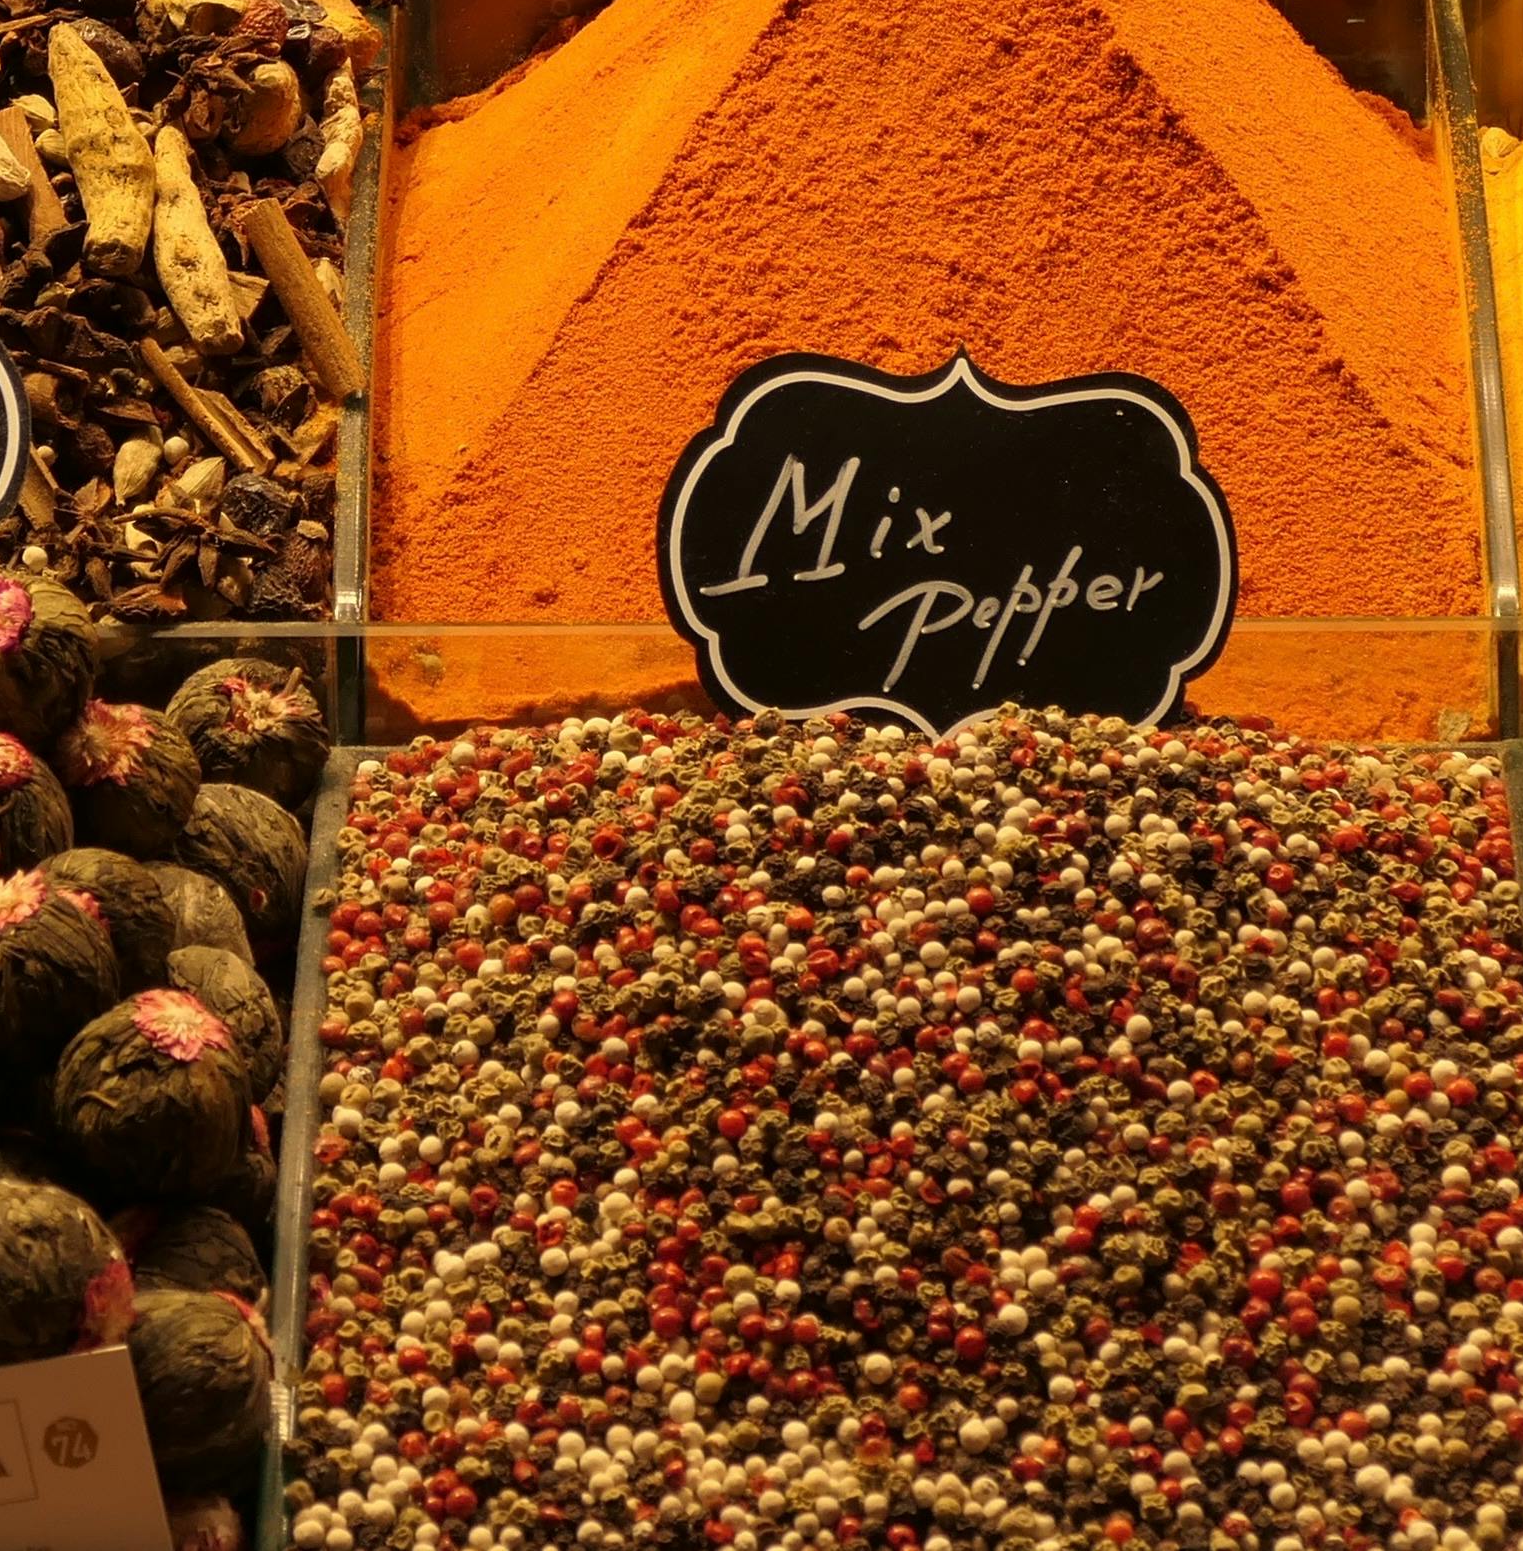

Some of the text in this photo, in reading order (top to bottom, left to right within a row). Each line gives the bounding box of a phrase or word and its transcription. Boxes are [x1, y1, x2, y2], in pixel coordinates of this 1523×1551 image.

[700, 453, 953, 598] Mix
[858, 545, 1164, 692] Pepper
[51, 1431, 91, 1464] 74
